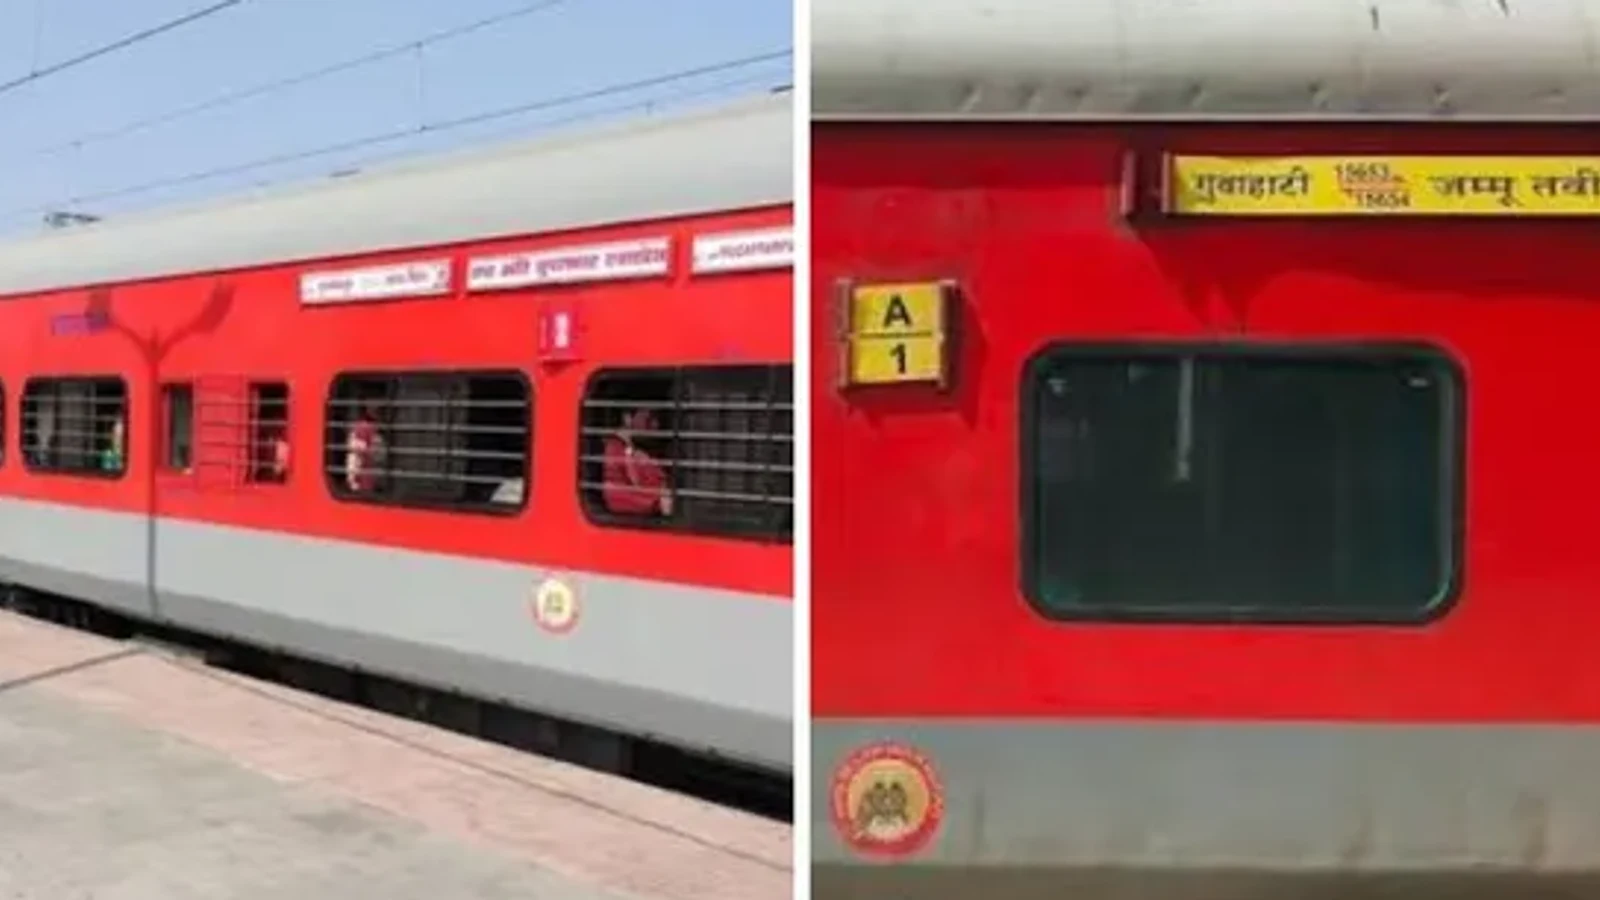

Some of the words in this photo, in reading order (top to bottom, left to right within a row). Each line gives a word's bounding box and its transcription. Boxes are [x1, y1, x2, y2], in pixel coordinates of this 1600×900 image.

[1192, 165, 1310, 203] गुवाहाटी
[1428, 175, 1522, 207] जम्मू
[883, 294, 913, 328] A
[889, 343, 906, 374] 1
